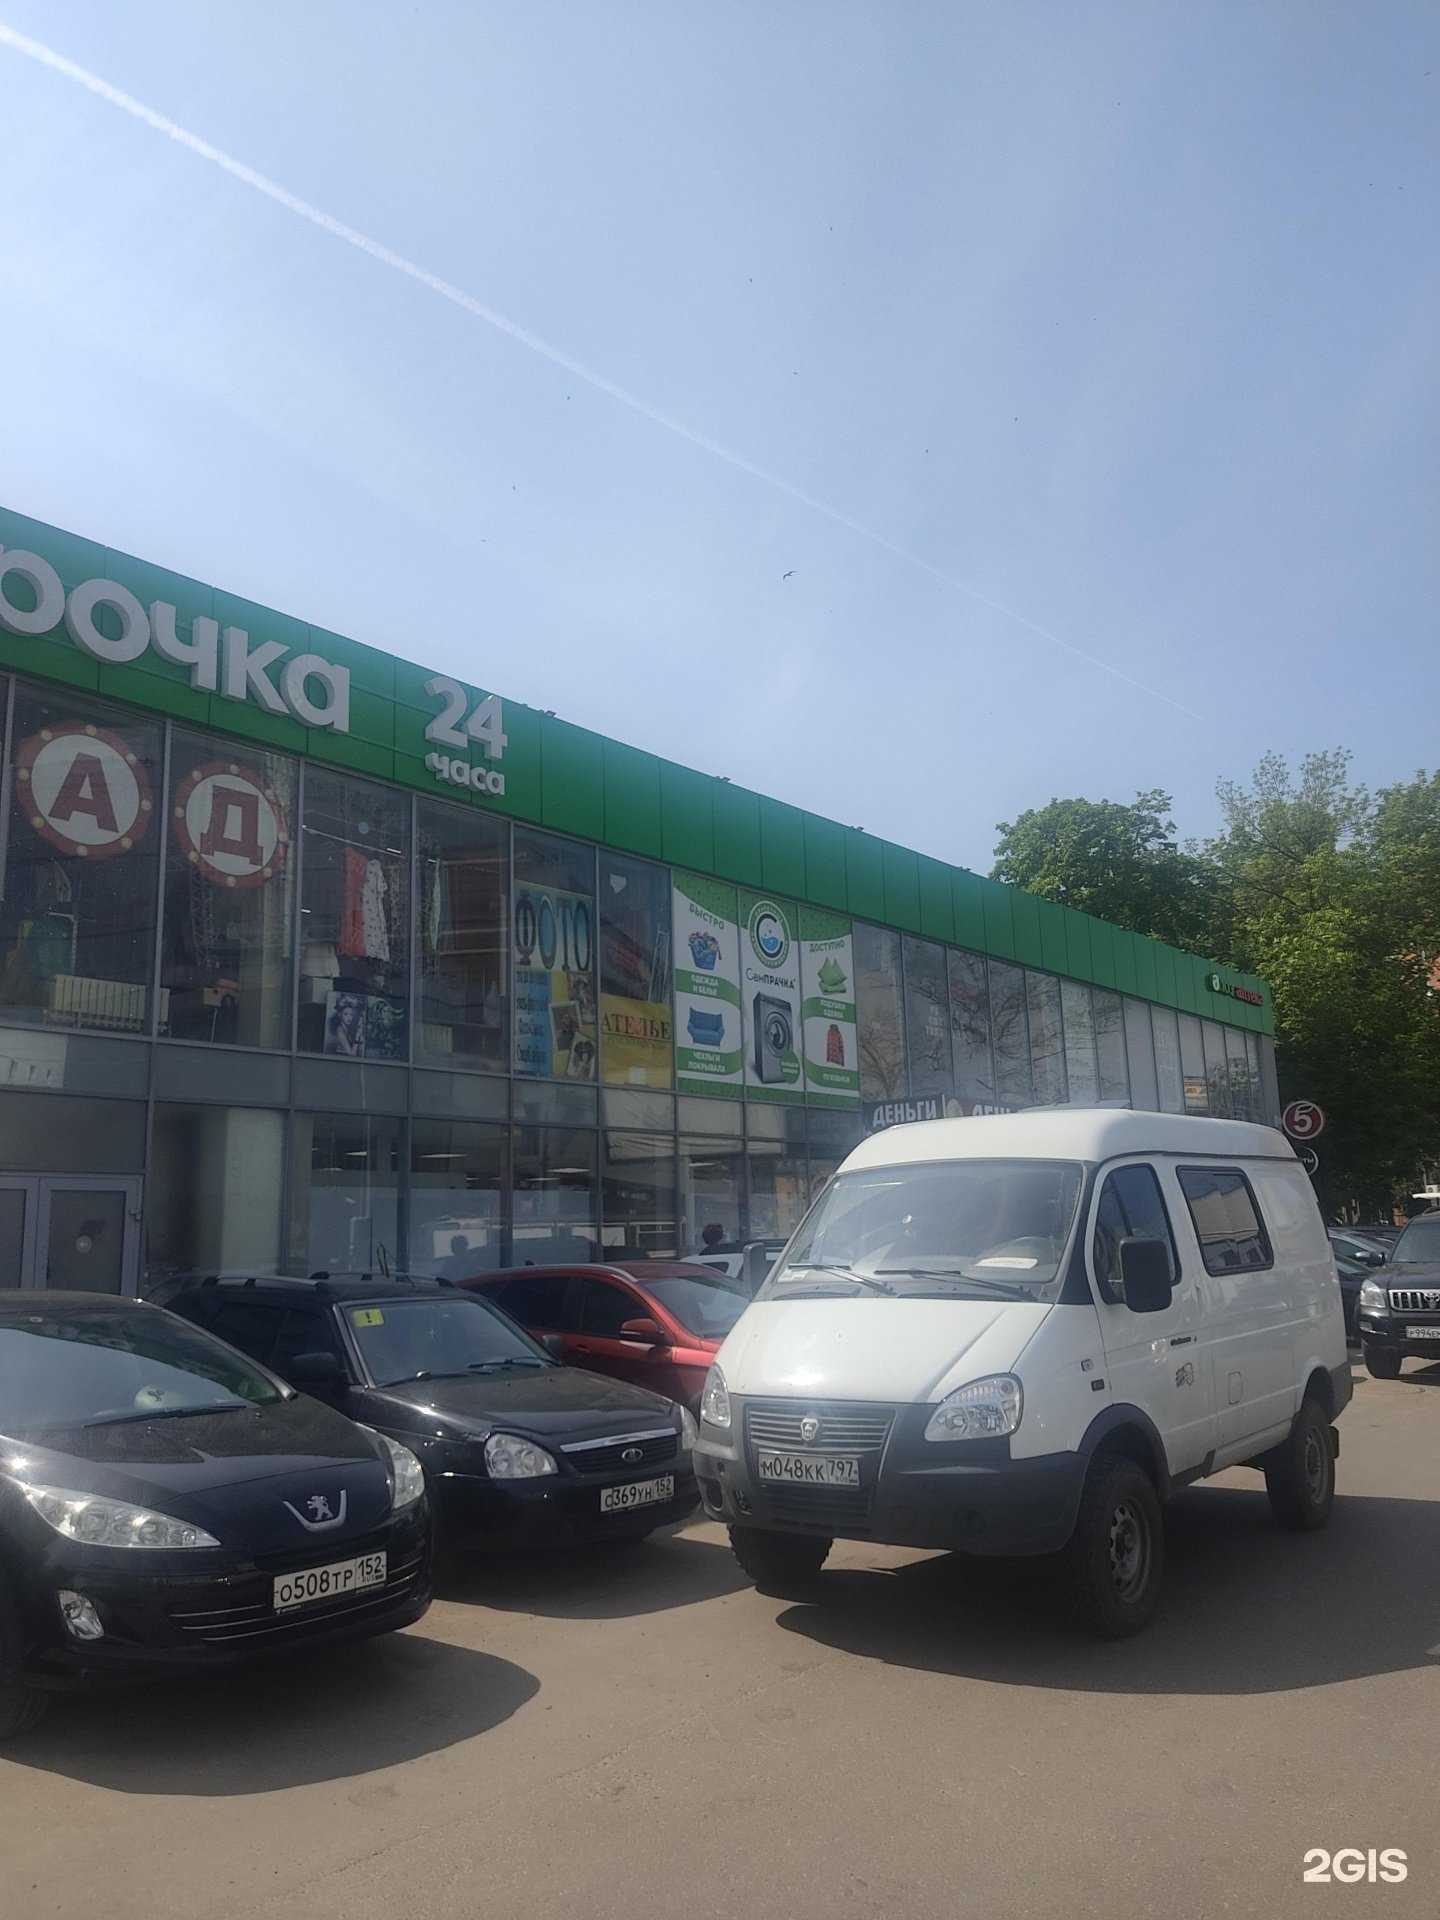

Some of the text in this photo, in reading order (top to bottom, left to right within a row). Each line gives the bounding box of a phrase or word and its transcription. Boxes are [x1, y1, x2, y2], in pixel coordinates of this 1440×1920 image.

[424, 676, 508, 760] 24
[425, 752, 505, 796] часа
[515, 891, 591, 971] ФОТО
[689, 903, 725, 930] БЫСТРО
[601, 1011, 672, 1040] АТЕЛЬЕ
[873, 1100, 937, 1127] ДЕНЬГИ
[358, 1555, 382, 1577] 152
